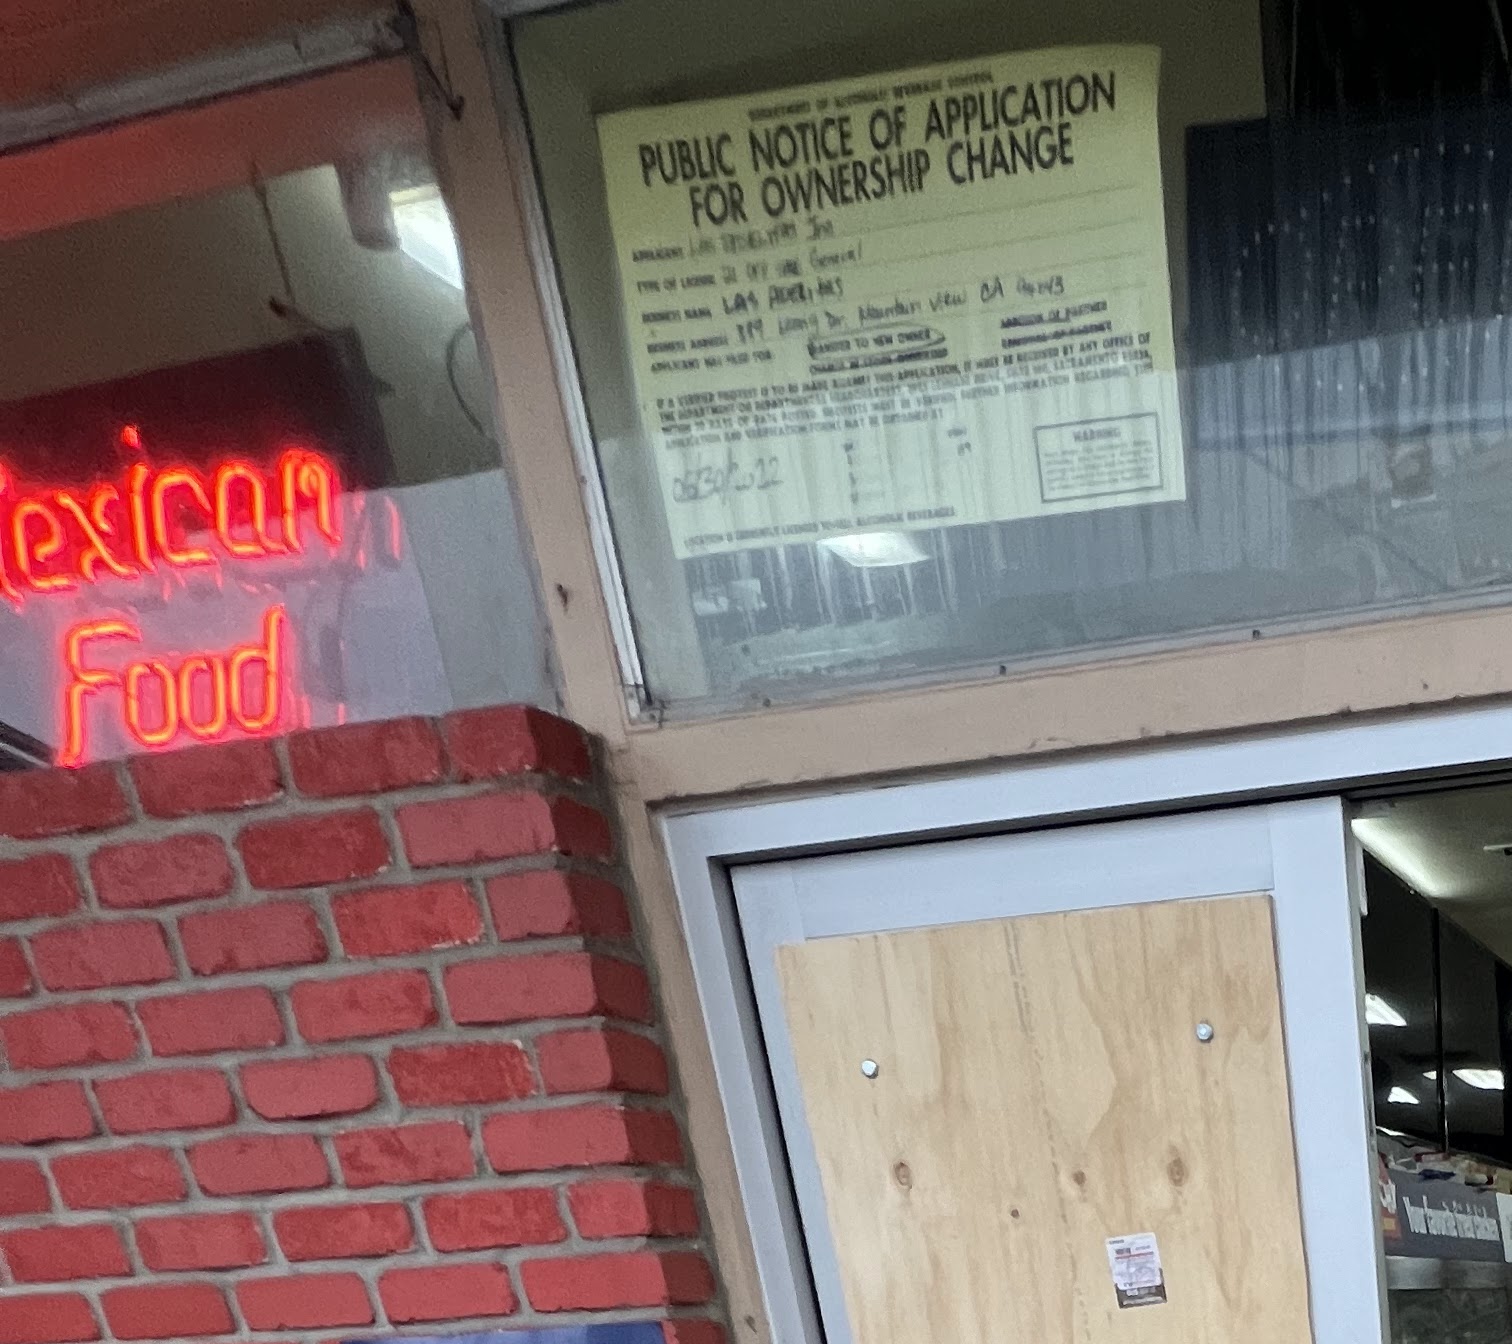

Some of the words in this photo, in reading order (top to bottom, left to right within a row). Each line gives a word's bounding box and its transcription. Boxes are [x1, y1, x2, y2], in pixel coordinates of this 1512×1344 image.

[639, 132, 736, 188] PUBLIC
[749, 115, 853, 173] NOTICE
[869, 105, 906, 151] OF
[925, 70, 1115, 143] APPLICATION
[689, 181, 748, 227] FOR
[761, 149, 931, 218] OWNERSHIP
[947, 122, 1074, 185] CHANGE
[0, 424, 344, 604] exican
[58, 603, 290, 768] Food
